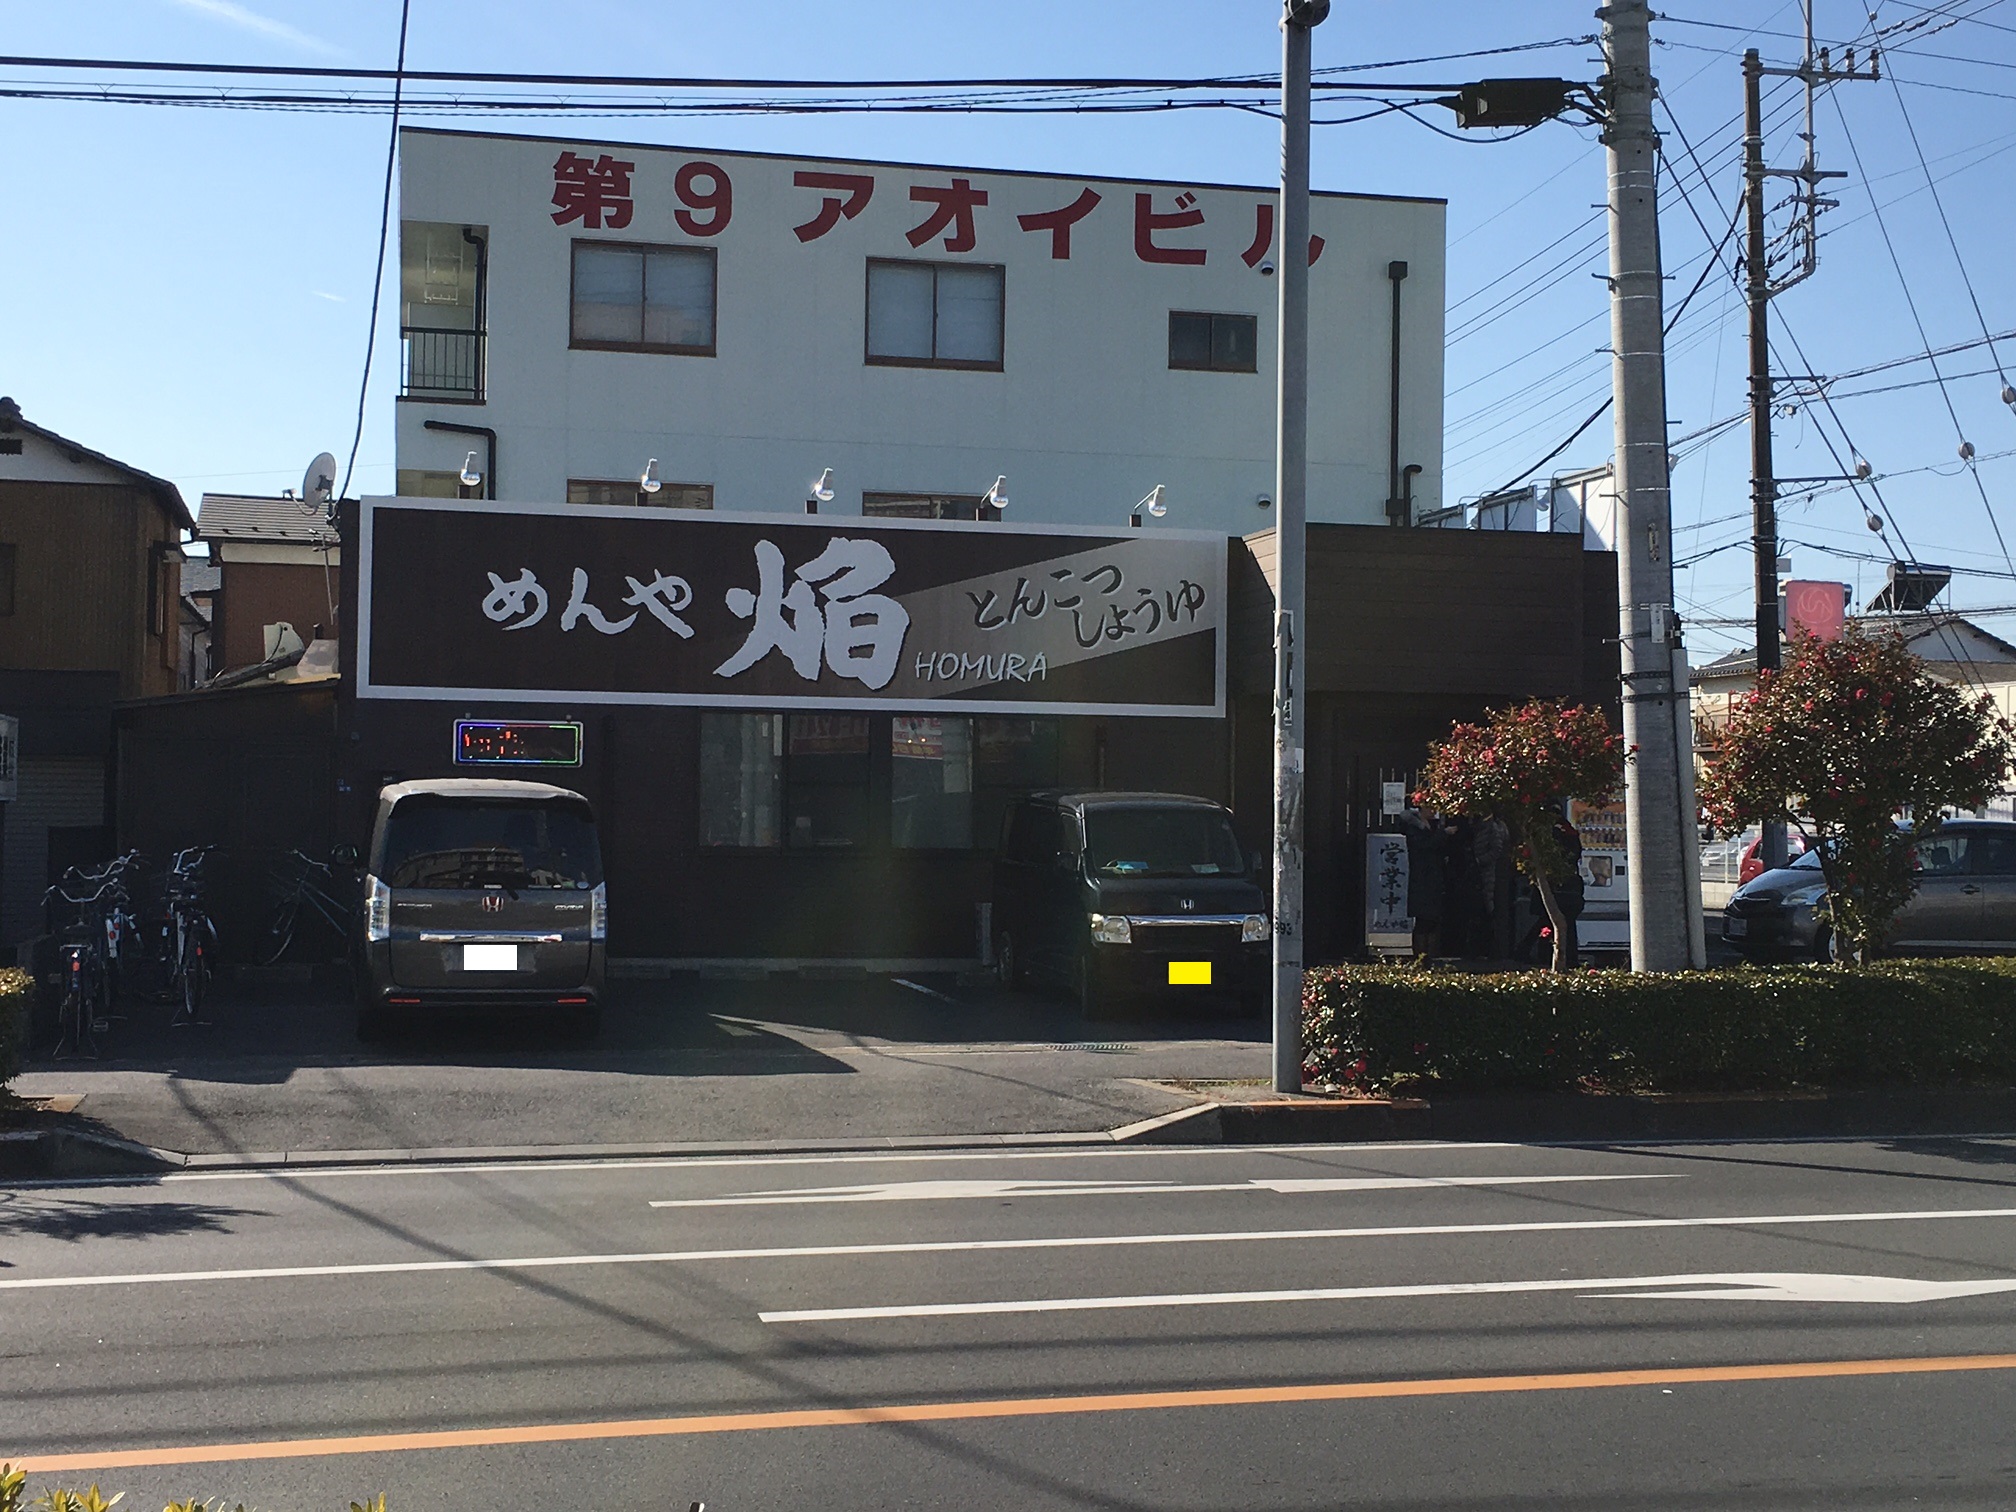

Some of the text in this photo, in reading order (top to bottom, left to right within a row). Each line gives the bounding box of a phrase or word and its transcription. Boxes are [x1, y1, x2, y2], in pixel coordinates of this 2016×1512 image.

[966, 564, 1124, 630] とんこつ
[1073, 579, 1207, 649] しょうゆ
[915, 651, 1047, 682] HOMURA
[1379, 842, 1406, 915] 営業中
